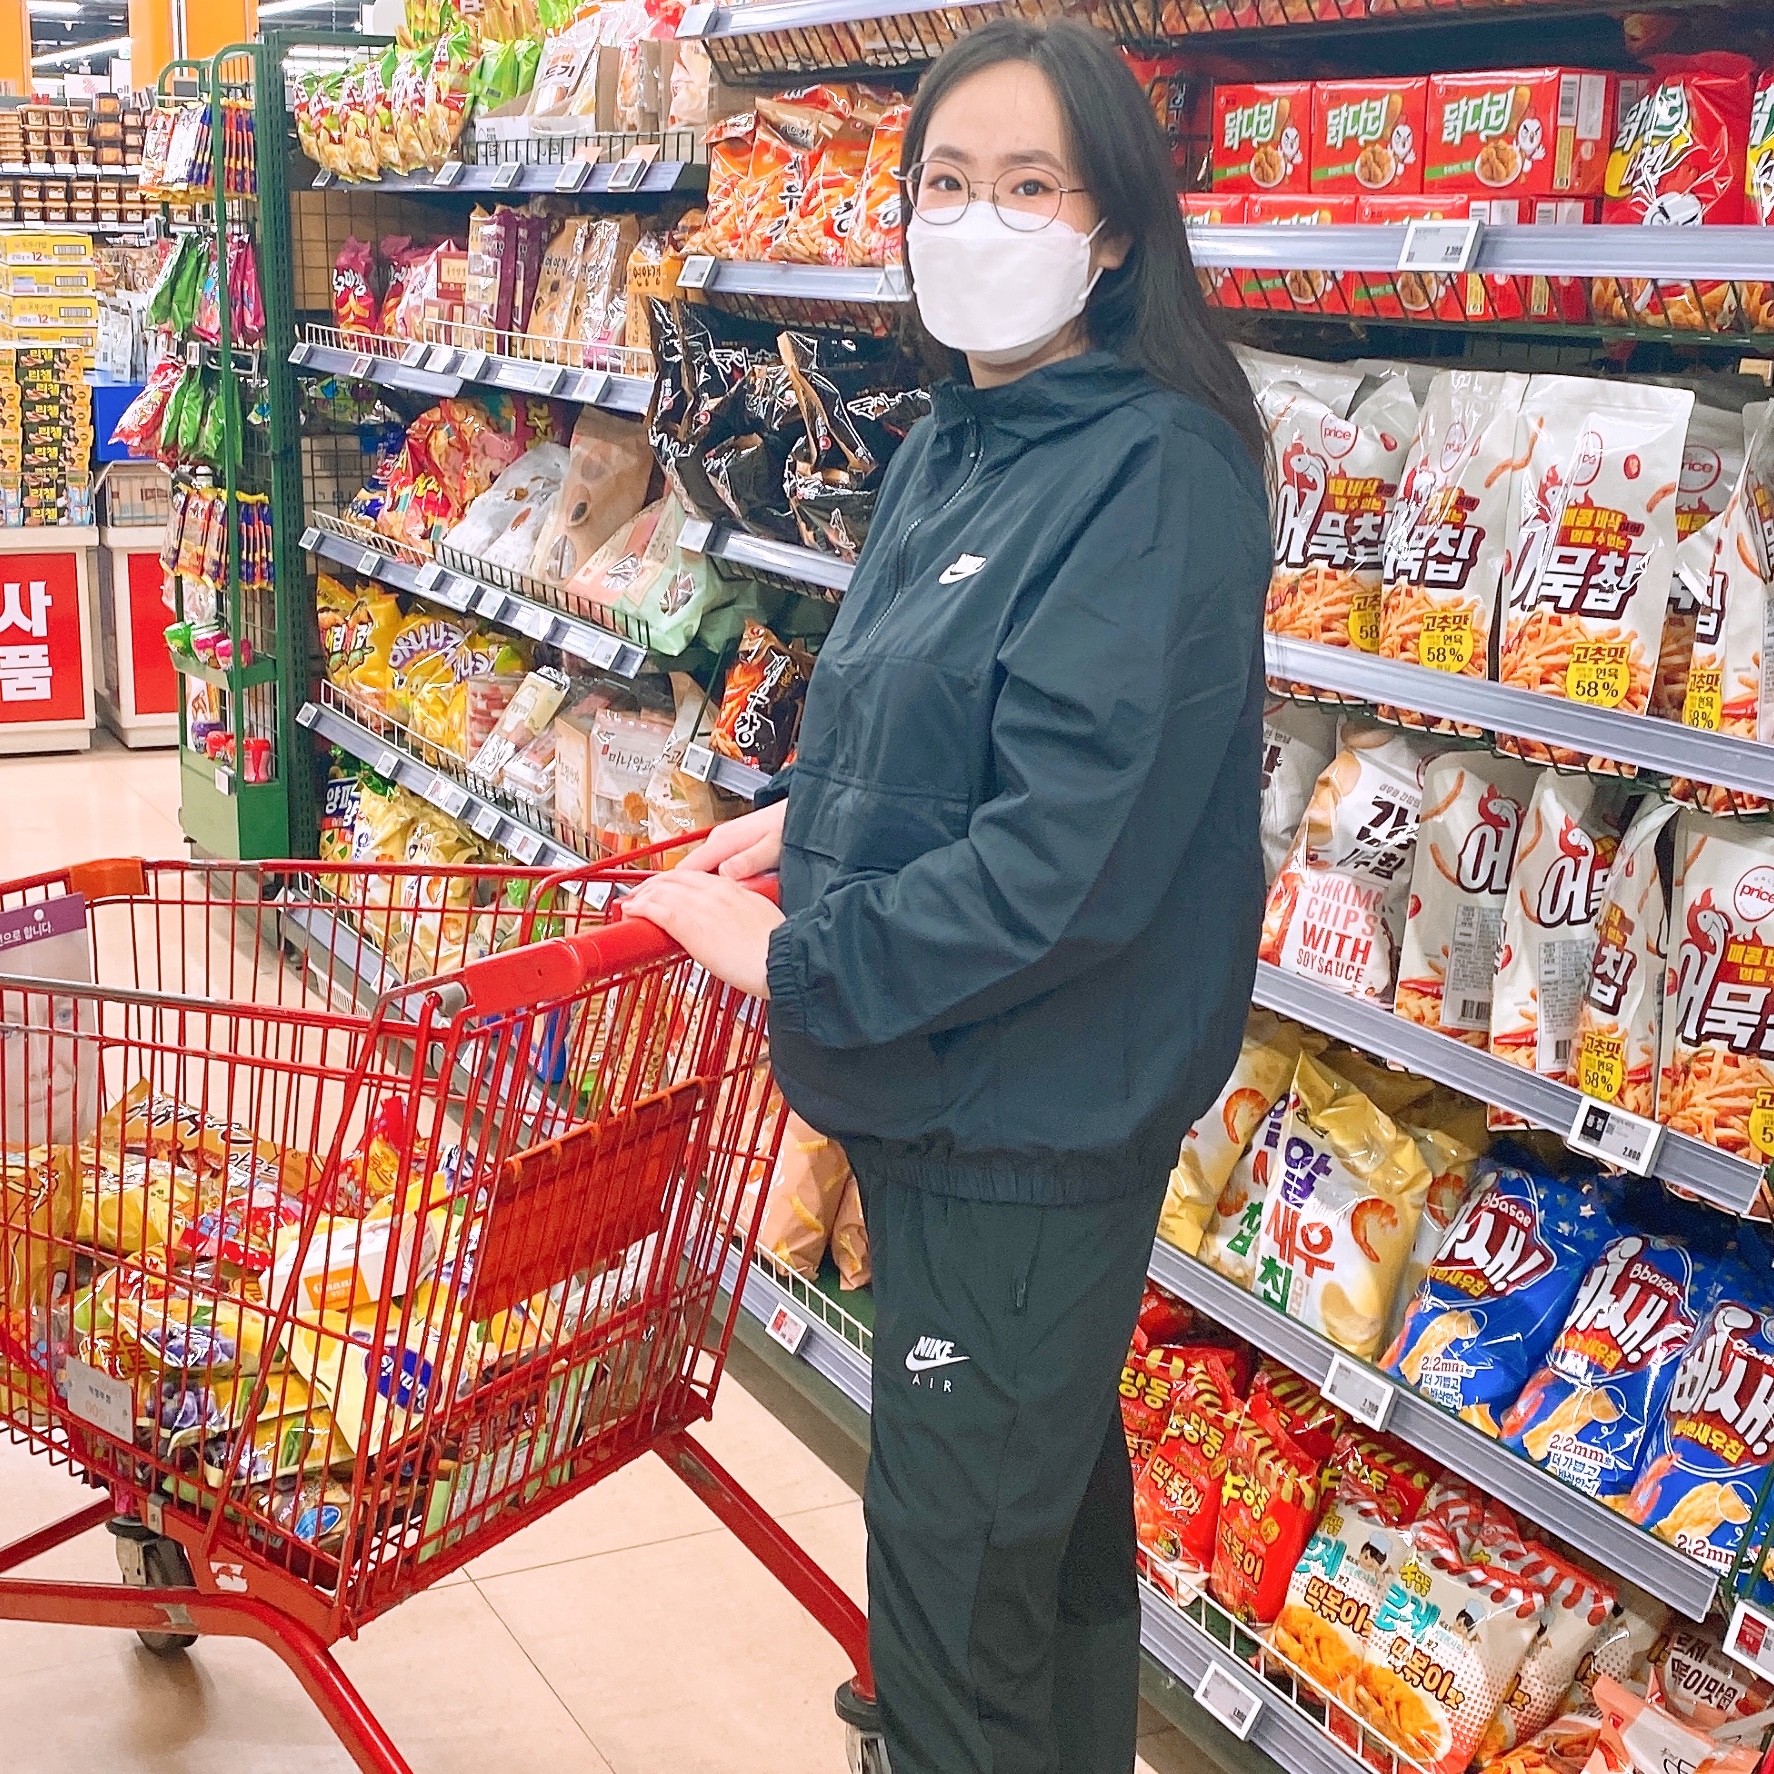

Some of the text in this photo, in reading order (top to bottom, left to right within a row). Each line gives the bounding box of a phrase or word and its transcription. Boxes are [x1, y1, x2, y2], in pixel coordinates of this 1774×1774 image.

[1223, 97, 1279, 150] 닭다리
[1325, 94, 1390, 149] 닭다리
[1442, 85, 1516, 145] 닭다리
[1323, 424, 1352, 440] price
[1424, 614, 1470, 632] 고추맛
[1572, 646, 1627, 665] 고추맛
[1311, 874, 1383, 911] SHRIMP
[1305, 894, 1379, 938] CHIPS
[1302, 918, 1373, 966] WITH
[1584, 1036, 1621, 1061] 고추맛
[914, 1335, 955, 1360] NIKE
[911, 1373, 952, 1393] AIR
